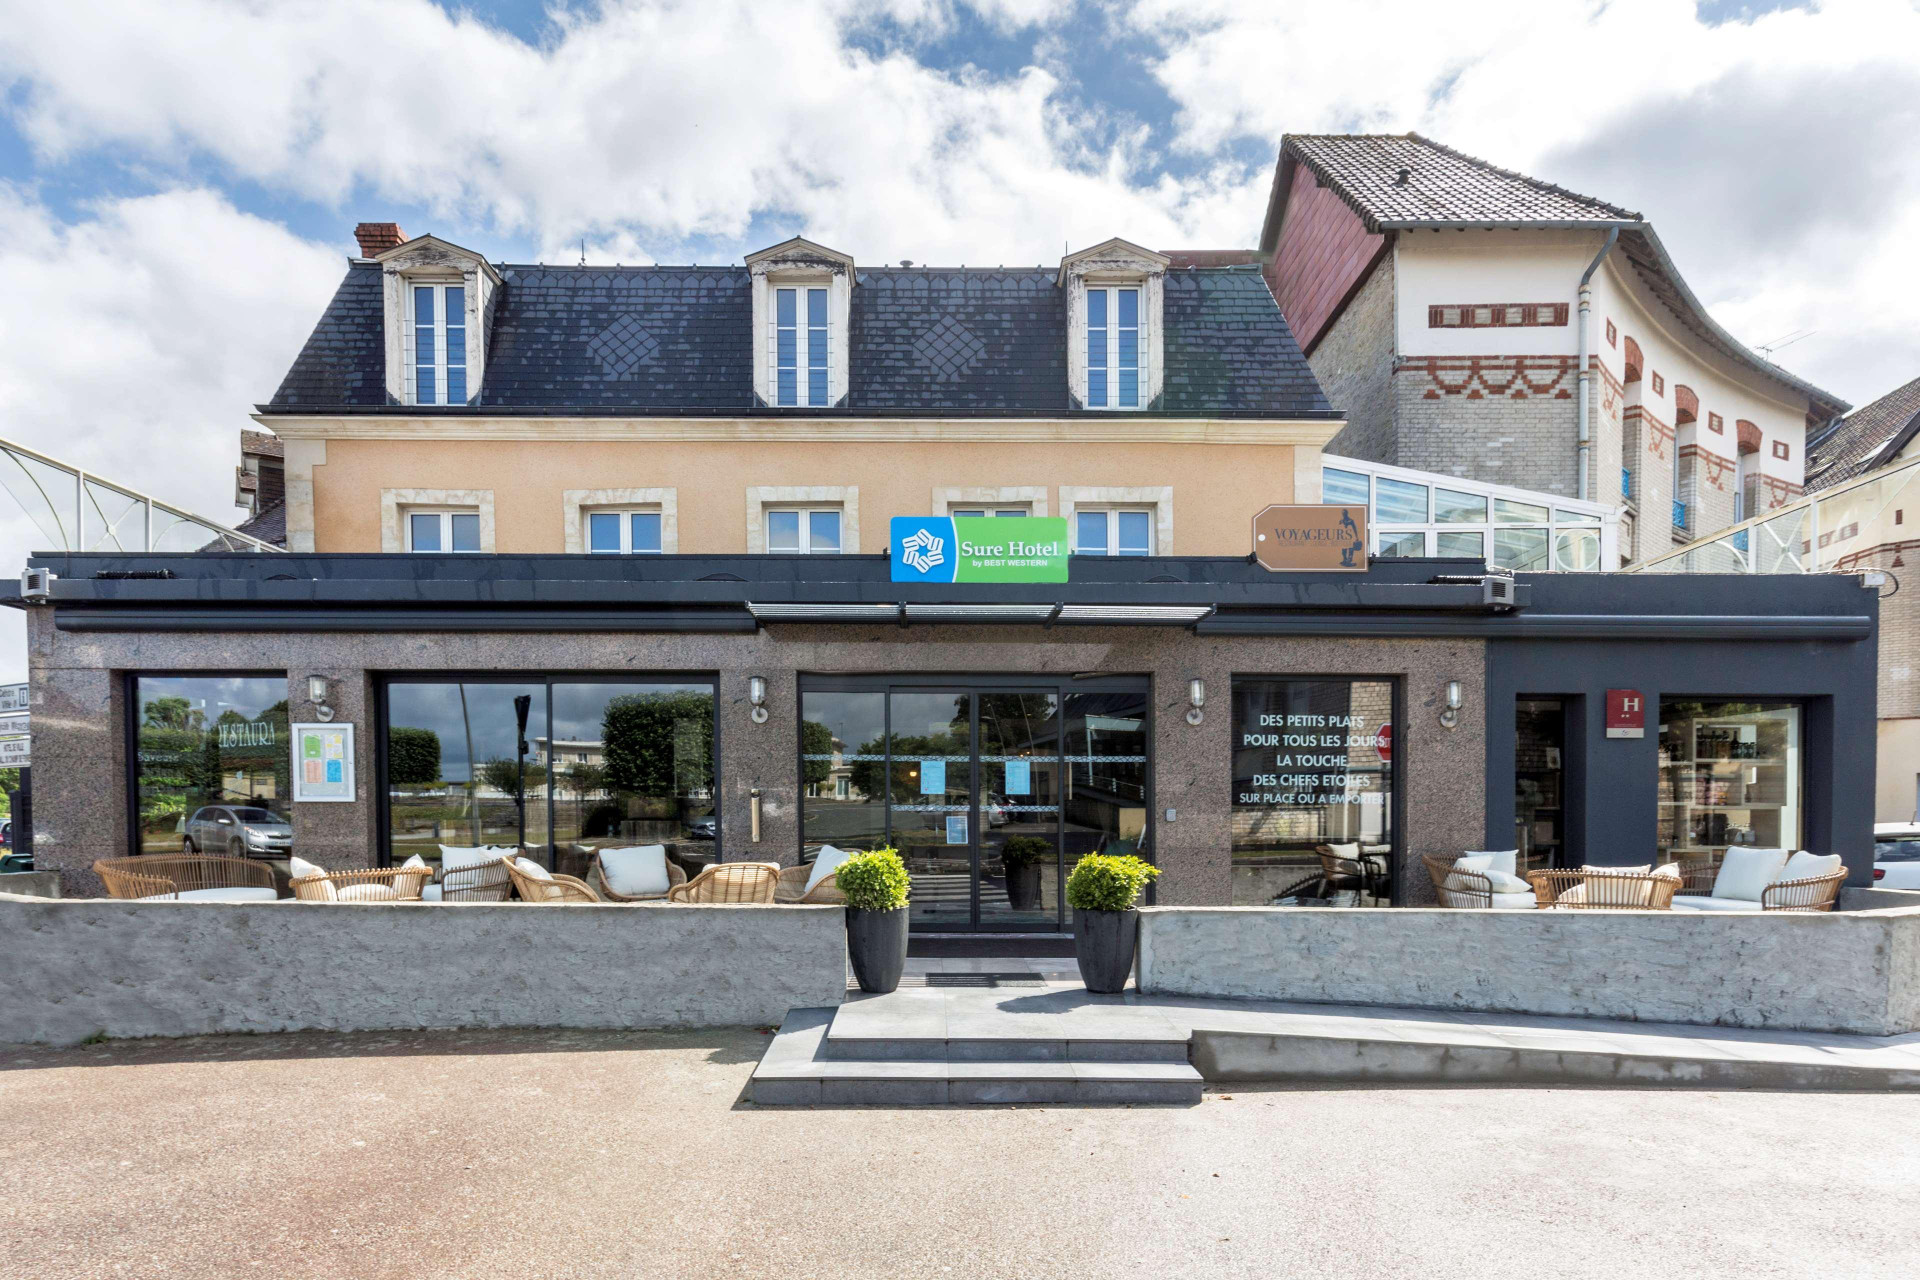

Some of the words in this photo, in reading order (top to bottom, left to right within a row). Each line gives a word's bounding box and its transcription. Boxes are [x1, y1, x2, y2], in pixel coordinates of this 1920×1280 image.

[1274, 528, 1353, 541] VOYAGEURS
[961, 541, 1003, 557] Sure
[1008, 541, 1059, 557] Hotel
[972, 559, 982, 568] by
[984, 559, 1005, 567] BEST
[1007, 559, 1048, 567] WESTERN
[1622, 697, 1640, 712] H
[1260, 714, 1283, 727] DES
[1287, 715, 1325, 728] PETITS
[1329, 715, 1365, 728] PLATS
[1244, 734, 1279, 746] POUR
[1282, 735, 1317, 747] TOUS
[1320, 735, 1341, 747] LES
[1344, 735, 1385, 748] JOURS
[1276, 754, 1292, 767] LA
[1296, 755, 1348, 767] TOUCHE
[1253, 774, 1277, 786] DES
[1280, 774, 1319, 787] CHEFS
[1322, 775, 1371, 787] ETOILES
[1239, 793, 1261, 803] SUR
[1263, 793, 1295, 804] PLACE
[1297, 793, 1315, 804] OU
[1318, 794, 1327, 804] A
[1329, 794, 1385, 805] EMPORTER
